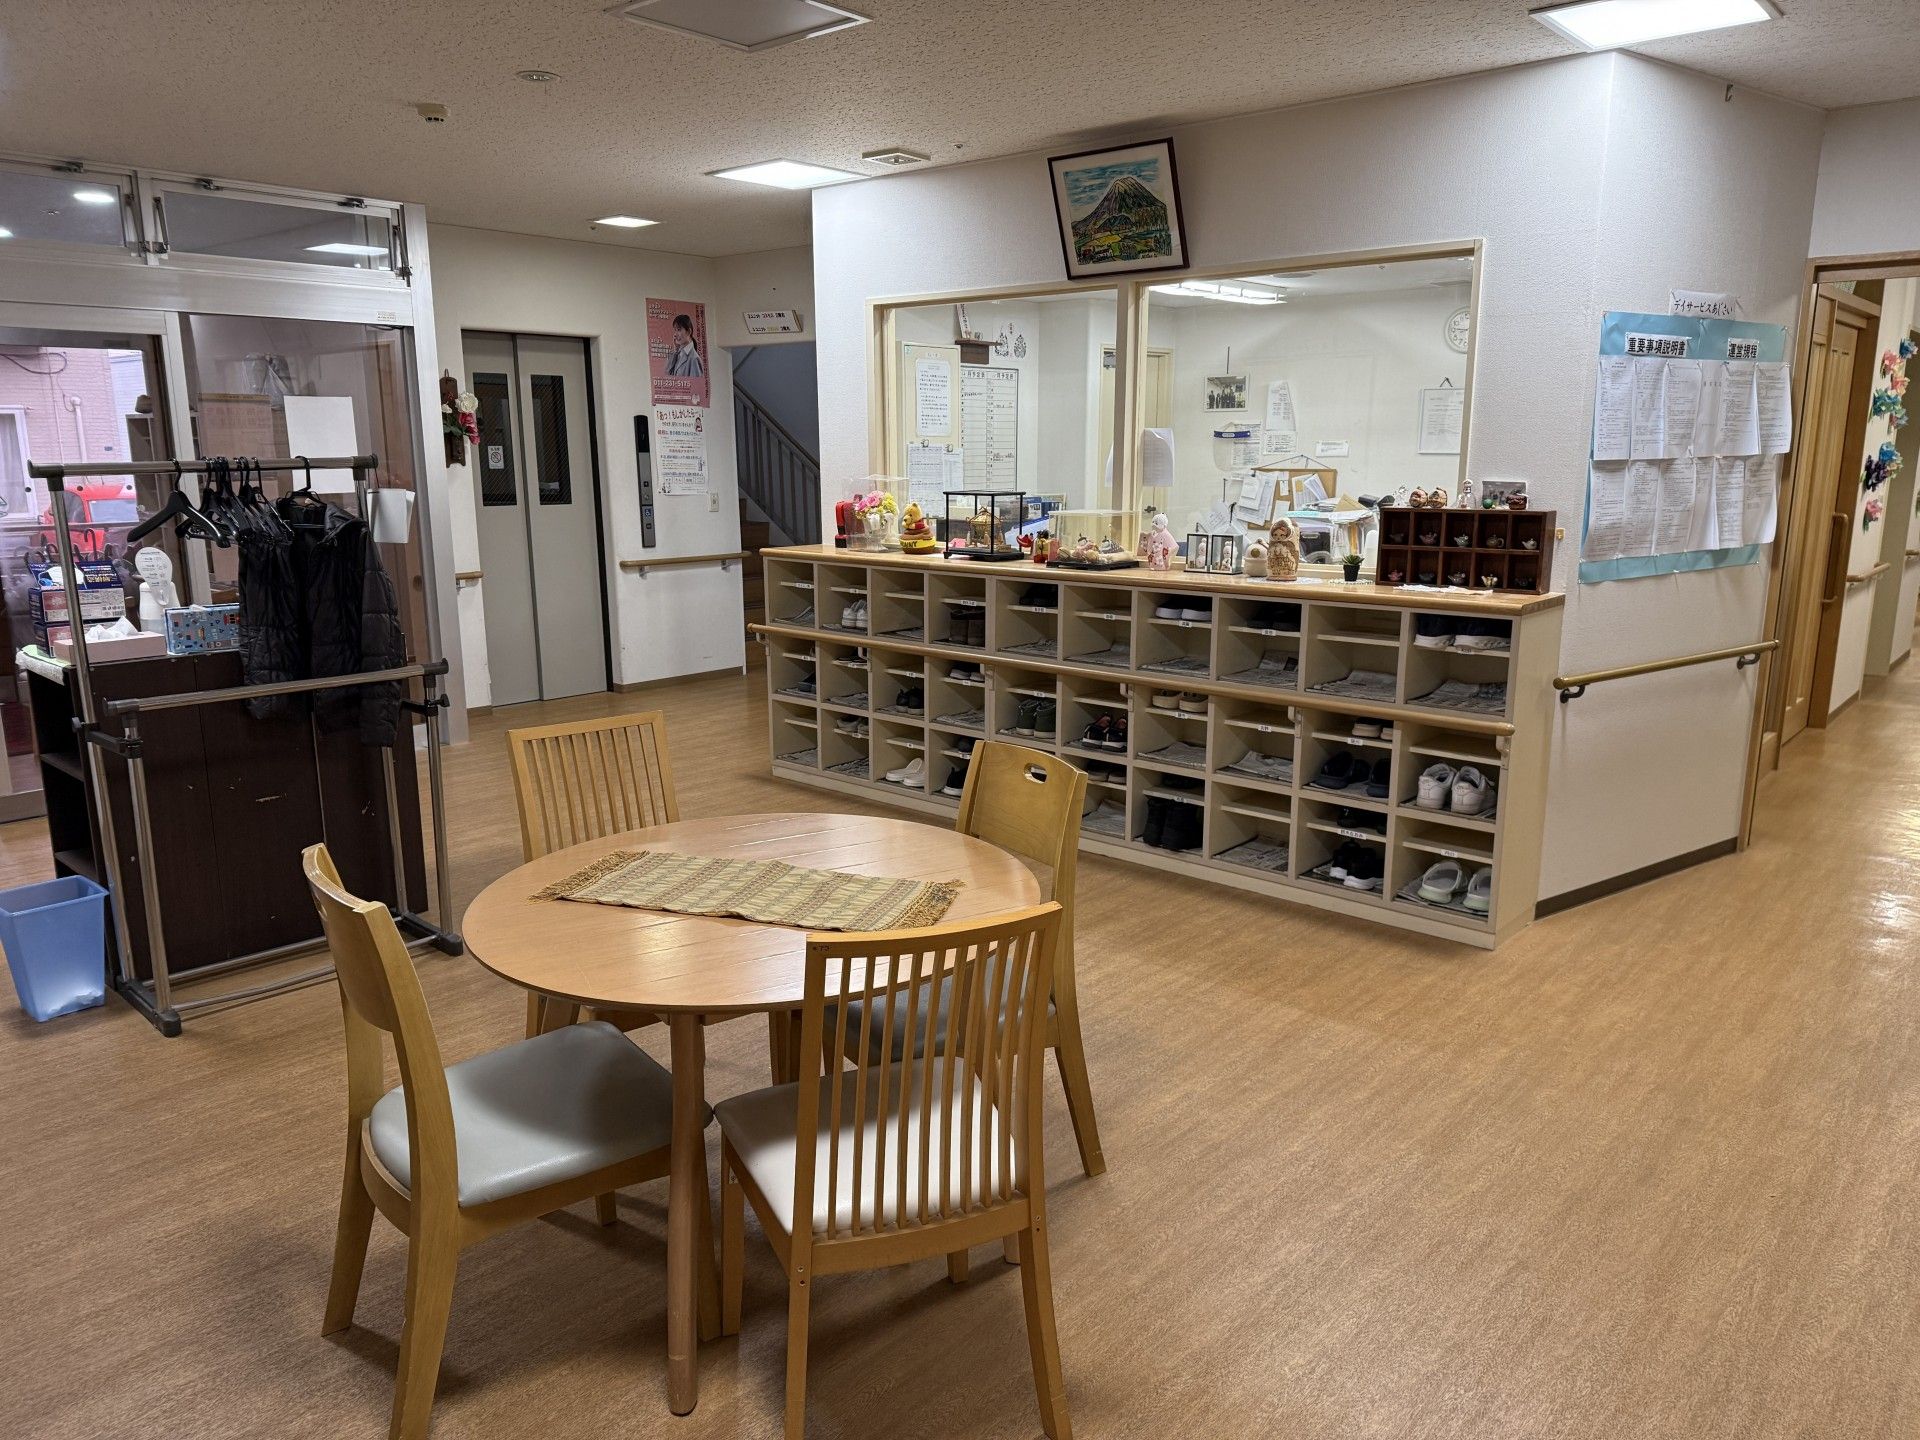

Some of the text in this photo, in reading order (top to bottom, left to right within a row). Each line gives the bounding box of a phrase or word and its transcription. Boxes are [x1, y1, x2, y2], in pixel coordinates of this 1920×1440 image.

[1674, 299, 1733, 316] デイサービスあじさい
[1628, 337, 1686, 356] 重要事項説明書
[1728, 343, 1757, 359] 運営規程
